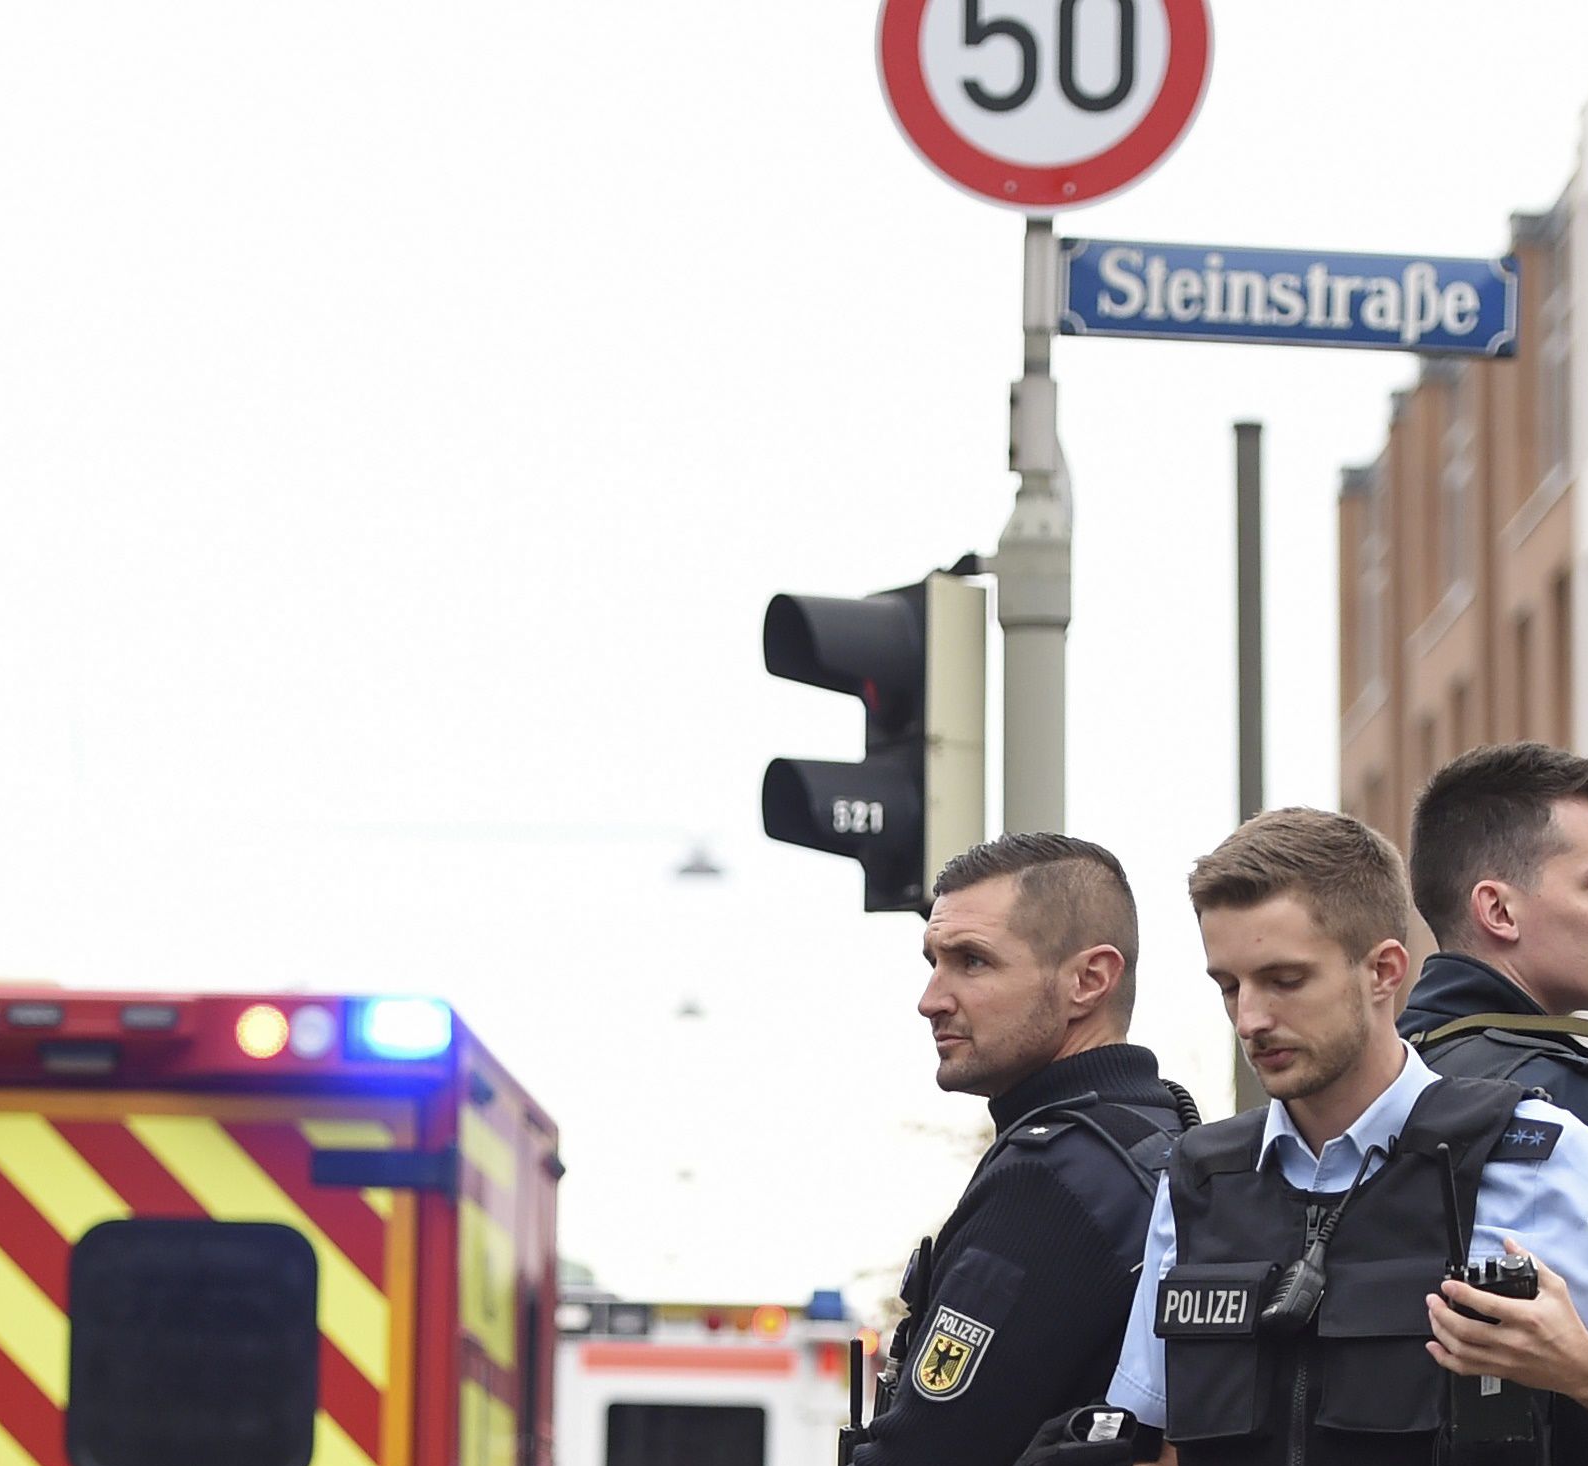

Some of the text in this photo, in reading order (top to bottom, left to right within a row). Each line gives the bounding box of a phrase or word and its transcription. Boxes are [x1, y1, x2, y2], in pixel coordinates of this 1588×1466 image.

[959, 0, 1139, 114] 50
[1096, 246, 1482, 343] Steinstraße
[936, 1312, 986, 1347] POLIZEI
[1164, 1289, 1248, 1324] POLIZEI
